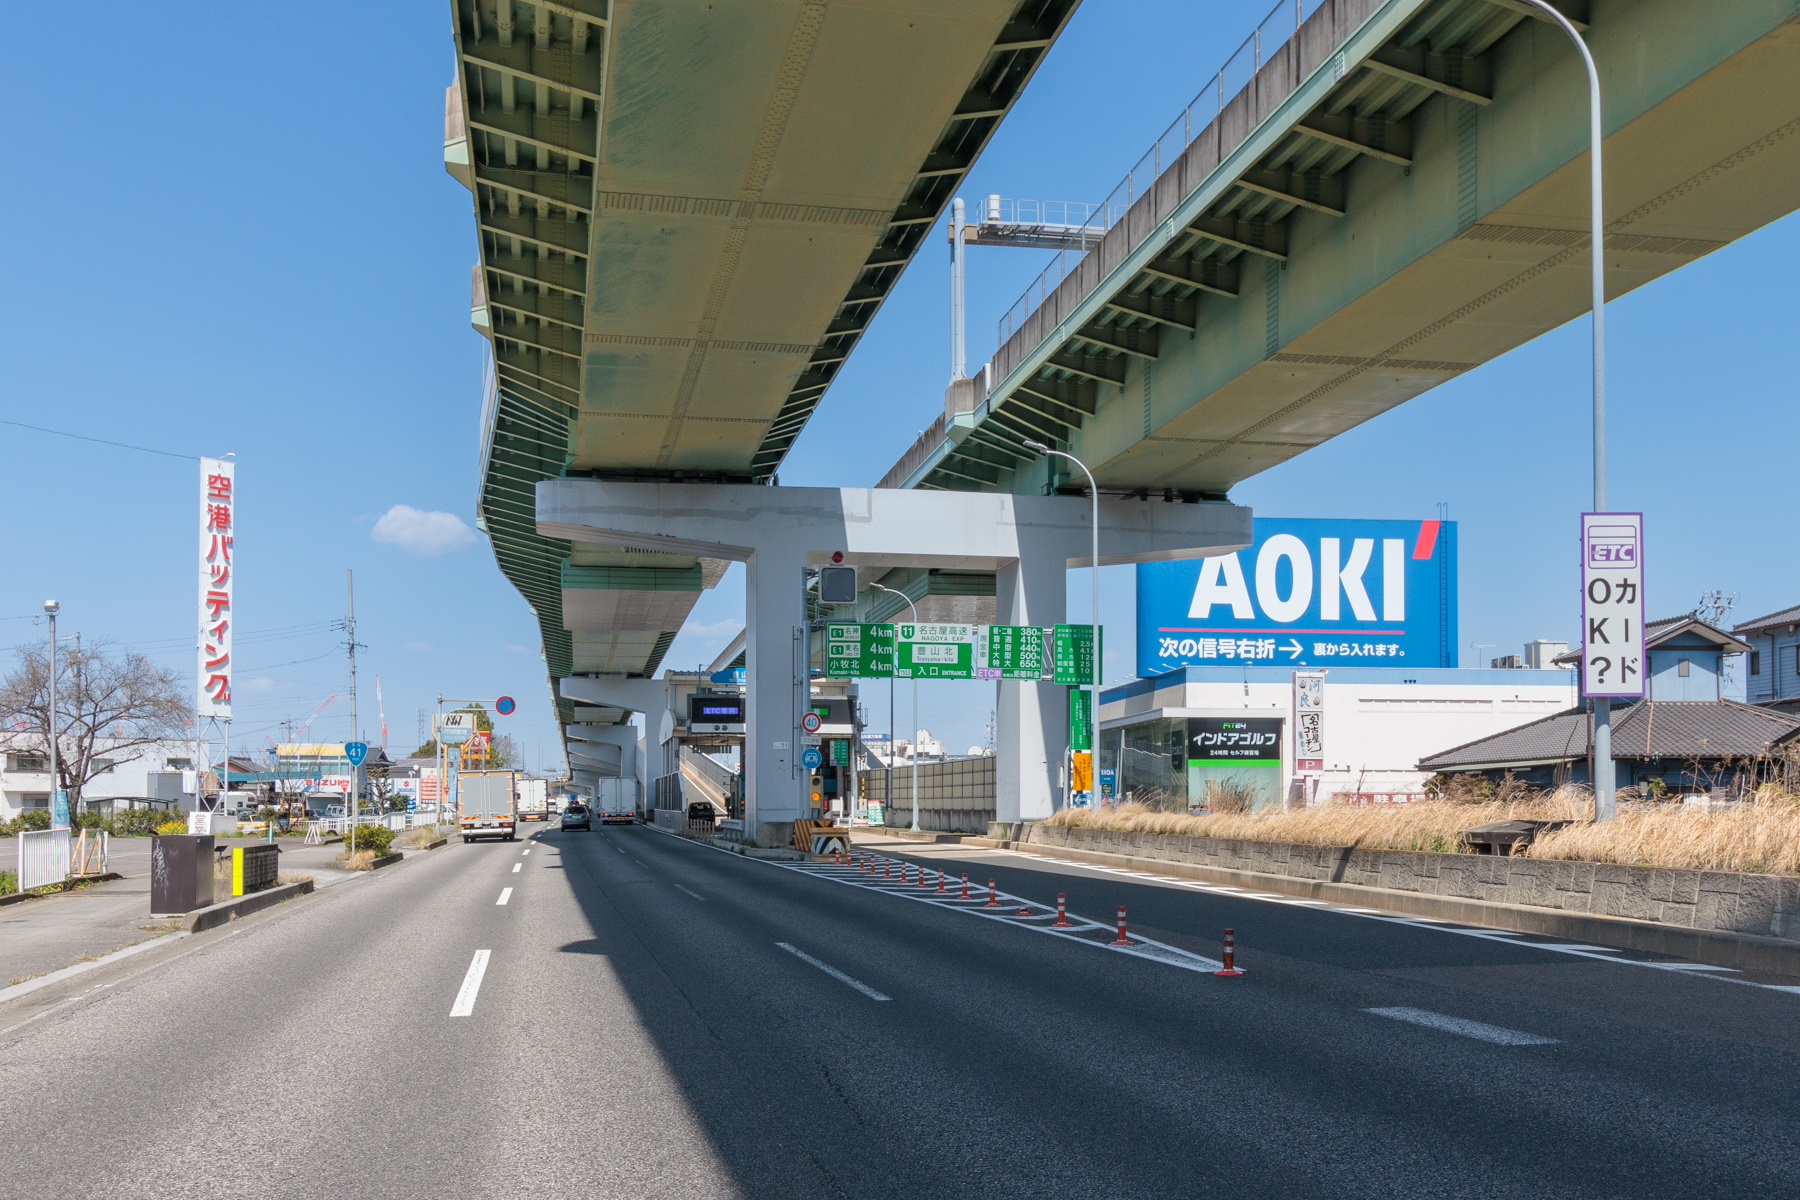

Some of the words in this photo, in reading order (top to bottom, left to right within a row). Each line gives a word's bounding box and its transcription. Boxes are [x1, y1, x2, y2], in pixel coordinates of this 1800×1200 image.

[1594, 545, 1633, 560] ETC
[1187, 533, 1405, 623] AOKI
[206, 474, 233, 700] 空港バッティング
[870, 626, 893, 637] 4km
[903, 627, 913, 636] 11
[919, 625, 968, 635] 名古屋高速
[1588, 578, 1611, 684] OK?
[1615, 578, 1637, 683] カード
[993, 635, 1012, 643] 普通
[870, 643, 892, 654] 4km
[917, 647, 953, 656] 豊山北
[979, 635, 987, 658] 現金車
[993, 643, 1012, 651] 中型
[1158, 637, 1276, 659] 次の信号右折
[1313, 642, 1405, 657] 裏から入れます。
[993, 652, 1012, 660] 大型
[830, 660, 860, 669] 小牧北
[870, 660, 892, 671] 4km
[918, 667, 939, 676] 入口
[978, 669, 1001, 678] ETC車
[806, 718, 817, 727] 40
[1193, 732, 1276, 746] インドアゴルフ
[349, 748, 362, 757] 41
[1305, 761, 1315, 769] P
